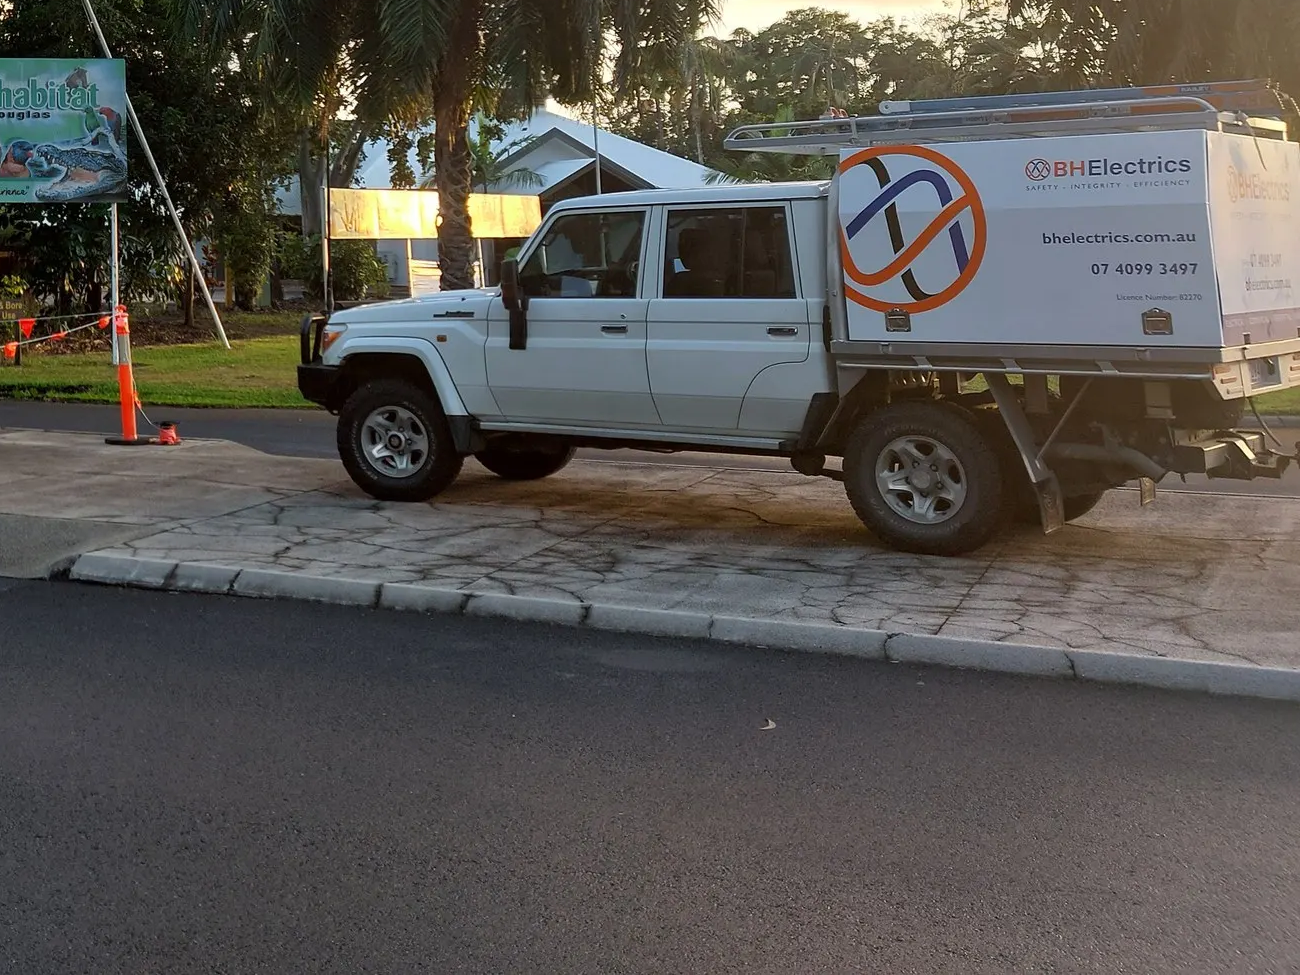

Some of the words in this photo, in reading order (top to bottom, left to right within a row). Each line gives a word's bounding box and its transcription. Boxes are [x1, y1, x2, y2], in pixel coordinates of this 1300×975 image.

[1053, 156, 1191, 177] BHElectrics
[1070, 182, 1122, 190] INTEGRITY
[1133, 179, 1191, 188] EFFICIENCY
[1042, 232, 1196, 244] bhelectrics.com.au
[1091, 263, 1109, 275] 07
[1115, 263, 1153, 275] 4099
[1159, 263, 1198, 275] 3497
[1179, 293, 1203, 301] 82270
[5, 301, 23, 310] Bore
[1, 311, 16, 320] Use
